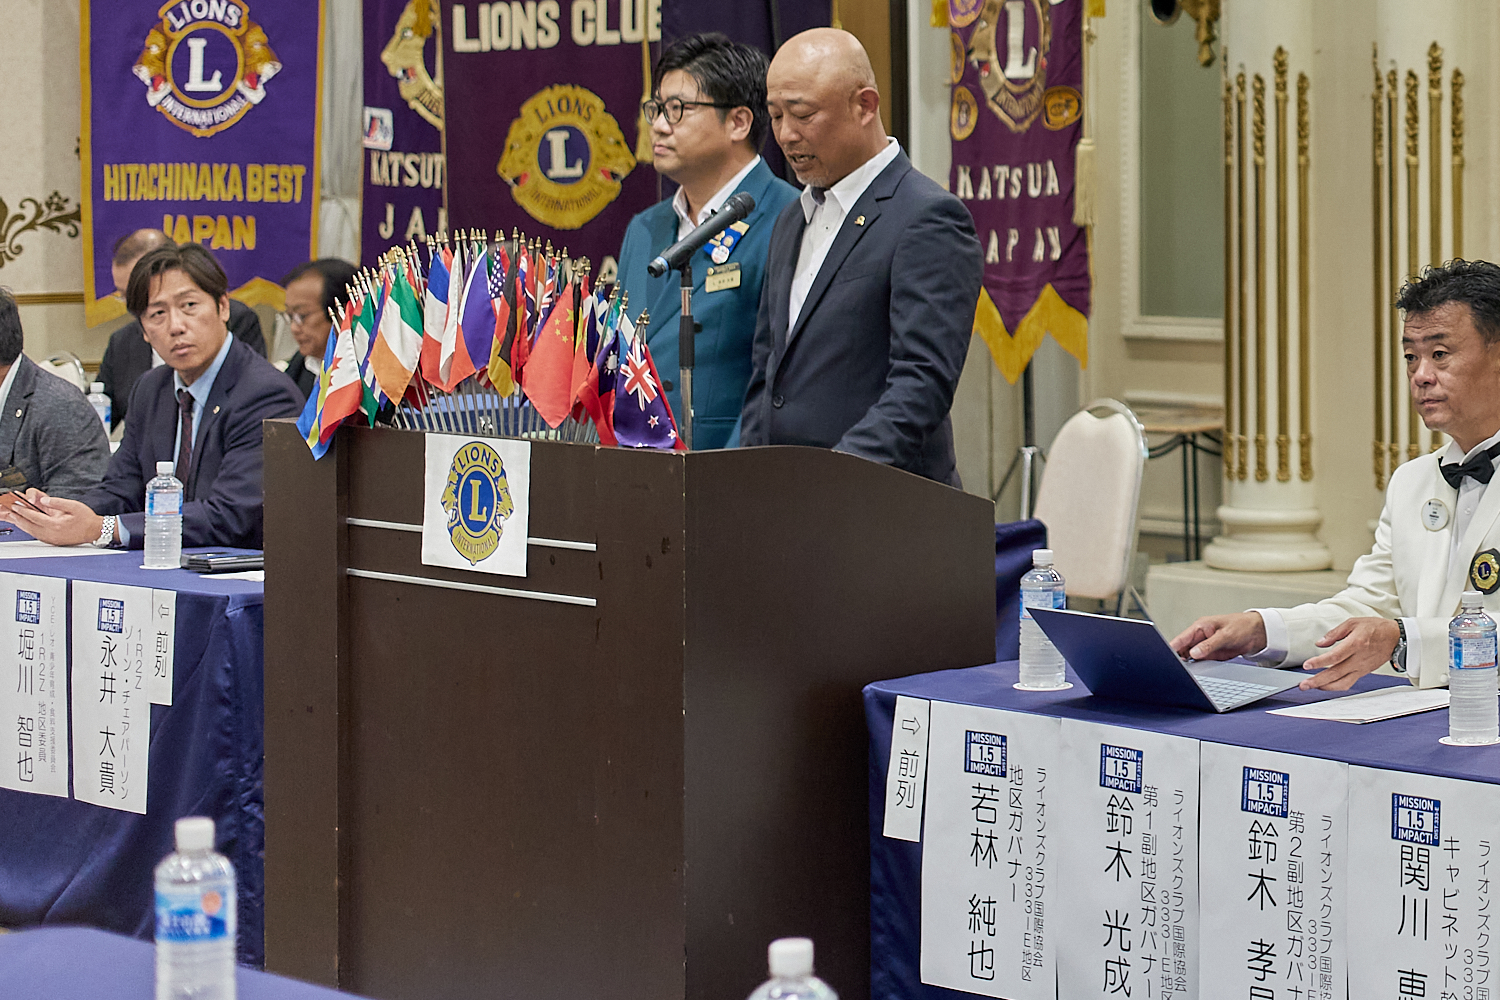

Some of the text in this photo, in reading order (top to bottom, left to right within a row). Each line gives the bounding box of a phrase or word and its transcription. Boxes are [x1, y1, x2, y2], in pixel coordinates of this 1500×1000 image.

[452, 0, 560, 53] LIONS
[1003, 0, 1037, 79] L
[184, 37, 223, 92] L
[161, 94, 249, 127] INTERNATIONAL
[534, 95, 596, 124] LIONS
[370, 150, 446, 190] KATSUT
[545, 129, 584, 179] L
[103, 163, 306, 203] HITACHINAKA BEST
[985, 226, 1062, 264] APAN
[457, 446, 500, 473] LIONS
[468, 479, 487, 522] L
[453, 531, 495, 555] INTERNATIONAL
[24, 601, 33, 613] 1.5
[106, 609, 116, 622] 1.5
[38, 632, 46, 692] 1R2Z
[135, 628, 143, 690] 1R2Z
[154, 630, 169, 678] 前列
[99, 635, 118, 795] 永井 大貴
[17, 714, 34, 783] 智也
[971, 732, 1002, 746] MISSION
[979, 745, 994, 763] 1.5
[1106, 745, 1138, 761] MISSION
[896, 748, 919, 809] 前列
[970, 761, 1002, 776] IMPACT!
[1105, 776, 1136, 792] IMPACT!
[1113, 759, 1129, 778] 1.5
[1249, 768, 1283, 784] MISSION
[1247, 800, 1282, 816] IMPACT!
[1257, 783, 1274, 802] 1.5
[1399, 795, 1434, 811] MISSION
[1008, 764, 1024, 902] 地区ガバナー
[1398, 828, 1433, 845] IMPACT!
[1407, 810, 1425, 830] 1.5
[967, 782, 1000, 981] 若林 純也
[1033, 767, 1047, 968] ライオンズクラブ国際協会
[1247, 819, 1279, 911] 鈴木
[1103, 794, 1134, 998] 鈴木 光成
[1141, 784, 1158, 998] 第1副地区ガバナー
[1172, 789, 1187, 993] ライオンズクラブ国際協会
[1397, 844, 1430, 941] 関川
